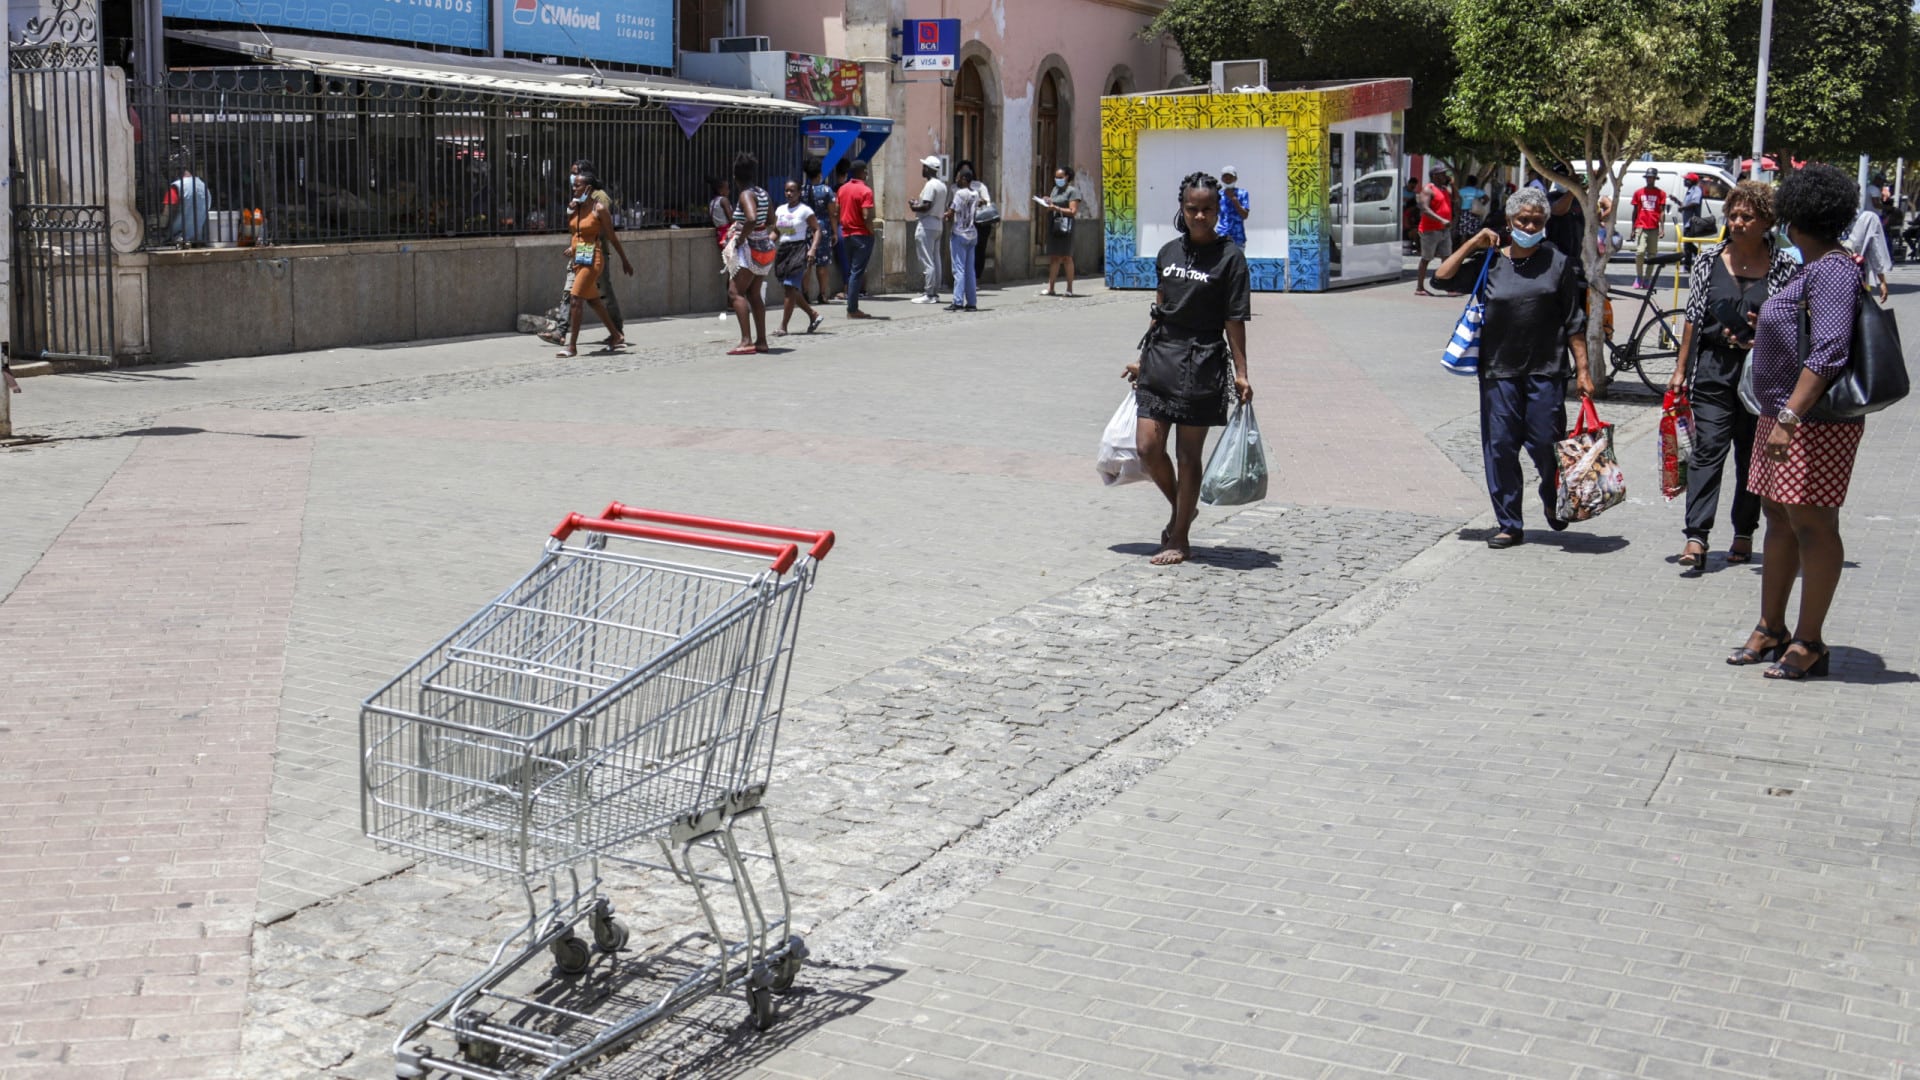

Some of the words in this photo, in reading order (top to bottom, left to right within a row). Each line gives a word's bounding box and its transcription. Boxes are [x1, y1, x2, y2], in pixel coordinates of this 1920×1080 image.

[541, 4, 600, 31] CVMóvel
[615, 13, 656, 28] ESTAMOS
[616, 28, 655, 41] LIGADOS
[920, 42, 937, 50] BCA
[920, 58, 937, 66] VISA
[820, 122, 833, 130] BCA
